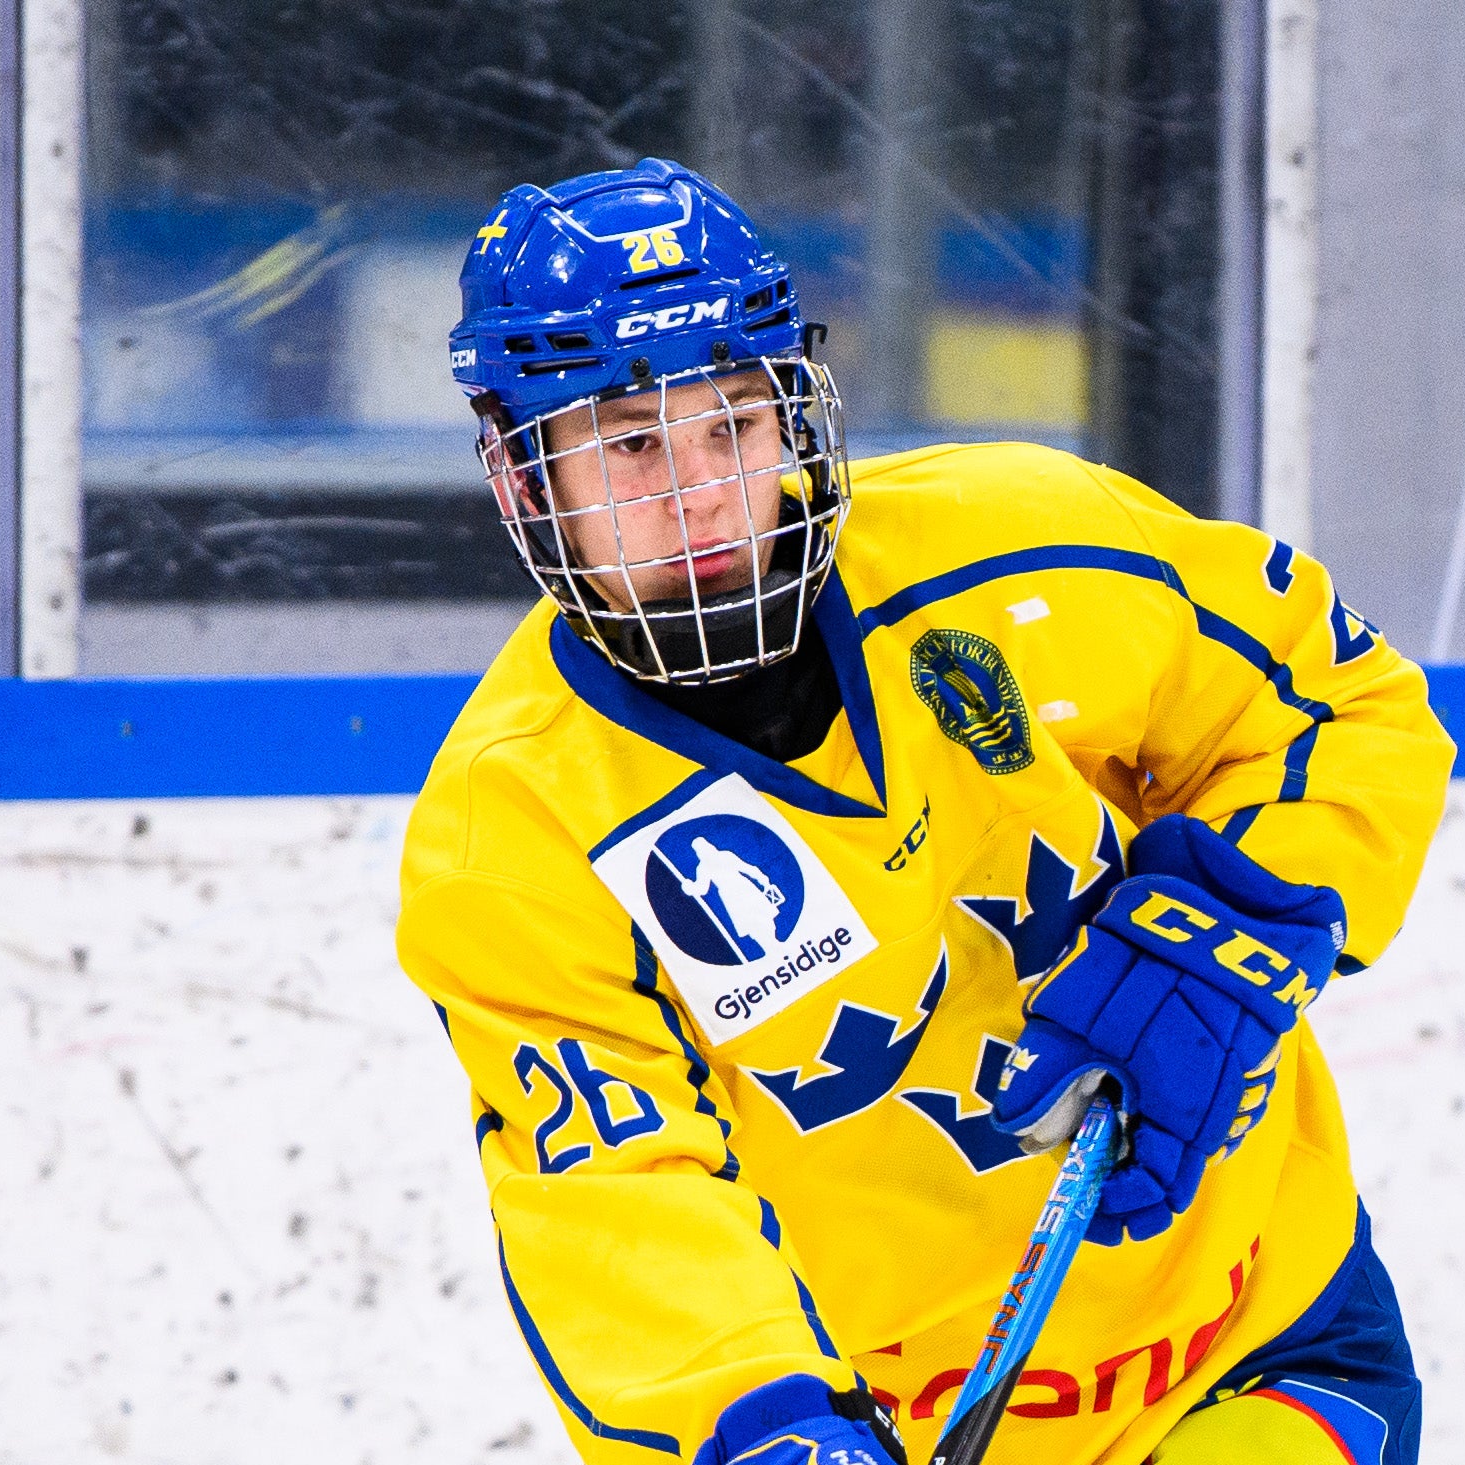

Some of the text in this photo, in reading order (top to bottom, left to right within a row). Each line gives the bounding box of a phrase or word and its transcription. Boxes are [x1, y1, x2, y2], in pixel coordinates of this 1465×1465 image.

[622, 230, 685, 274] 26
[615, 297, 730, 339] CCM
[451, 348, 477, 369] CCM
[714, 926, 852, 1020] Gjensidige
[1130, 890, 1318, 1019] CCM
[512, 1036, 668, 1175] 26
